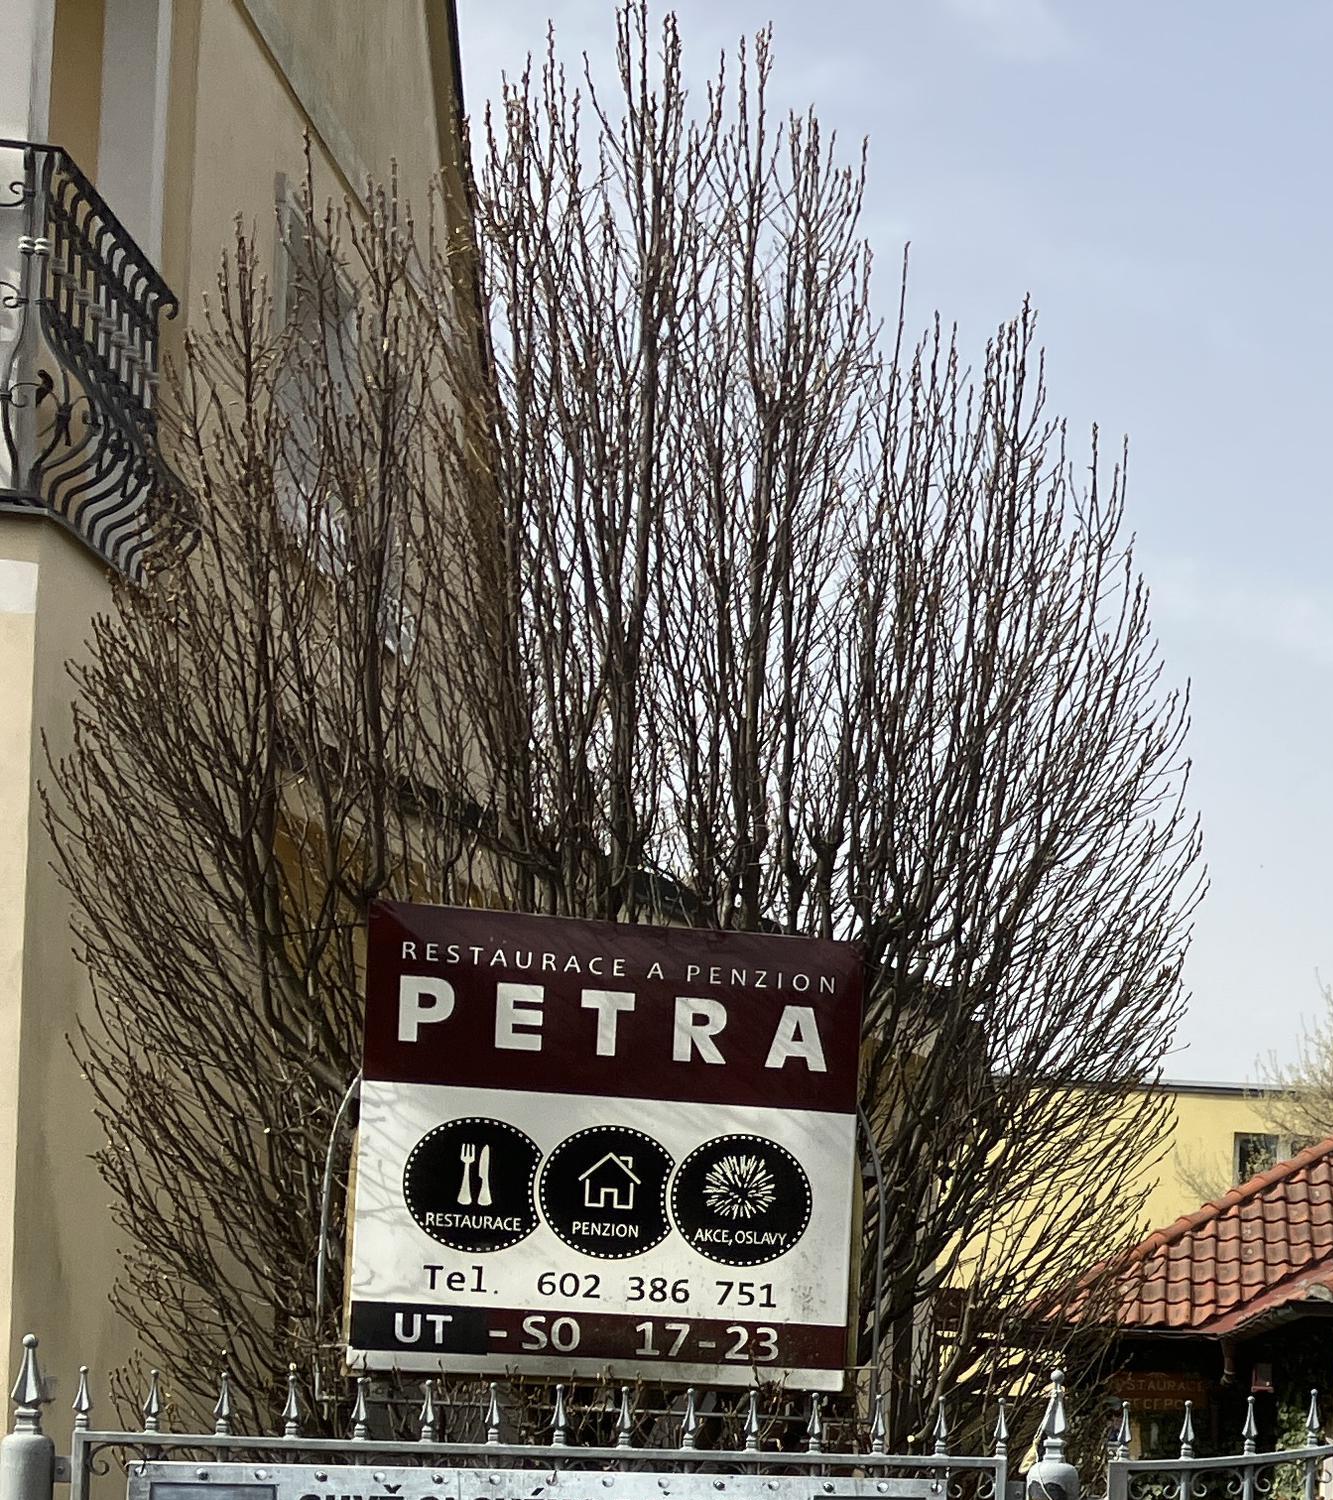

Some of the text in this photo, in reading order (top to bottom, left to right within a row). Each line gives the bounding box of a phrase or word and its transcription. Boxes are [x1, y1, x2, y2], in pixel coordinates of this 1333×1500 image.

[401, 941, 838, 994] RESTAURACE A PENZION
[397, 975, 829, 1072] PETRA
[424, 1211, 522, 1233] RESTAURACE
[572, 1221, 640, 1239] PENZION
[735, 1230, 787, 1247] OSLAVY
[423, 1264, 777, 1309] Tel. 602 386 751
[393, 1312, 453, 1345] UT
[634, 1321, 780, 1361] 17-23
[1109, 1379, 1206, 1392] STAURACE
